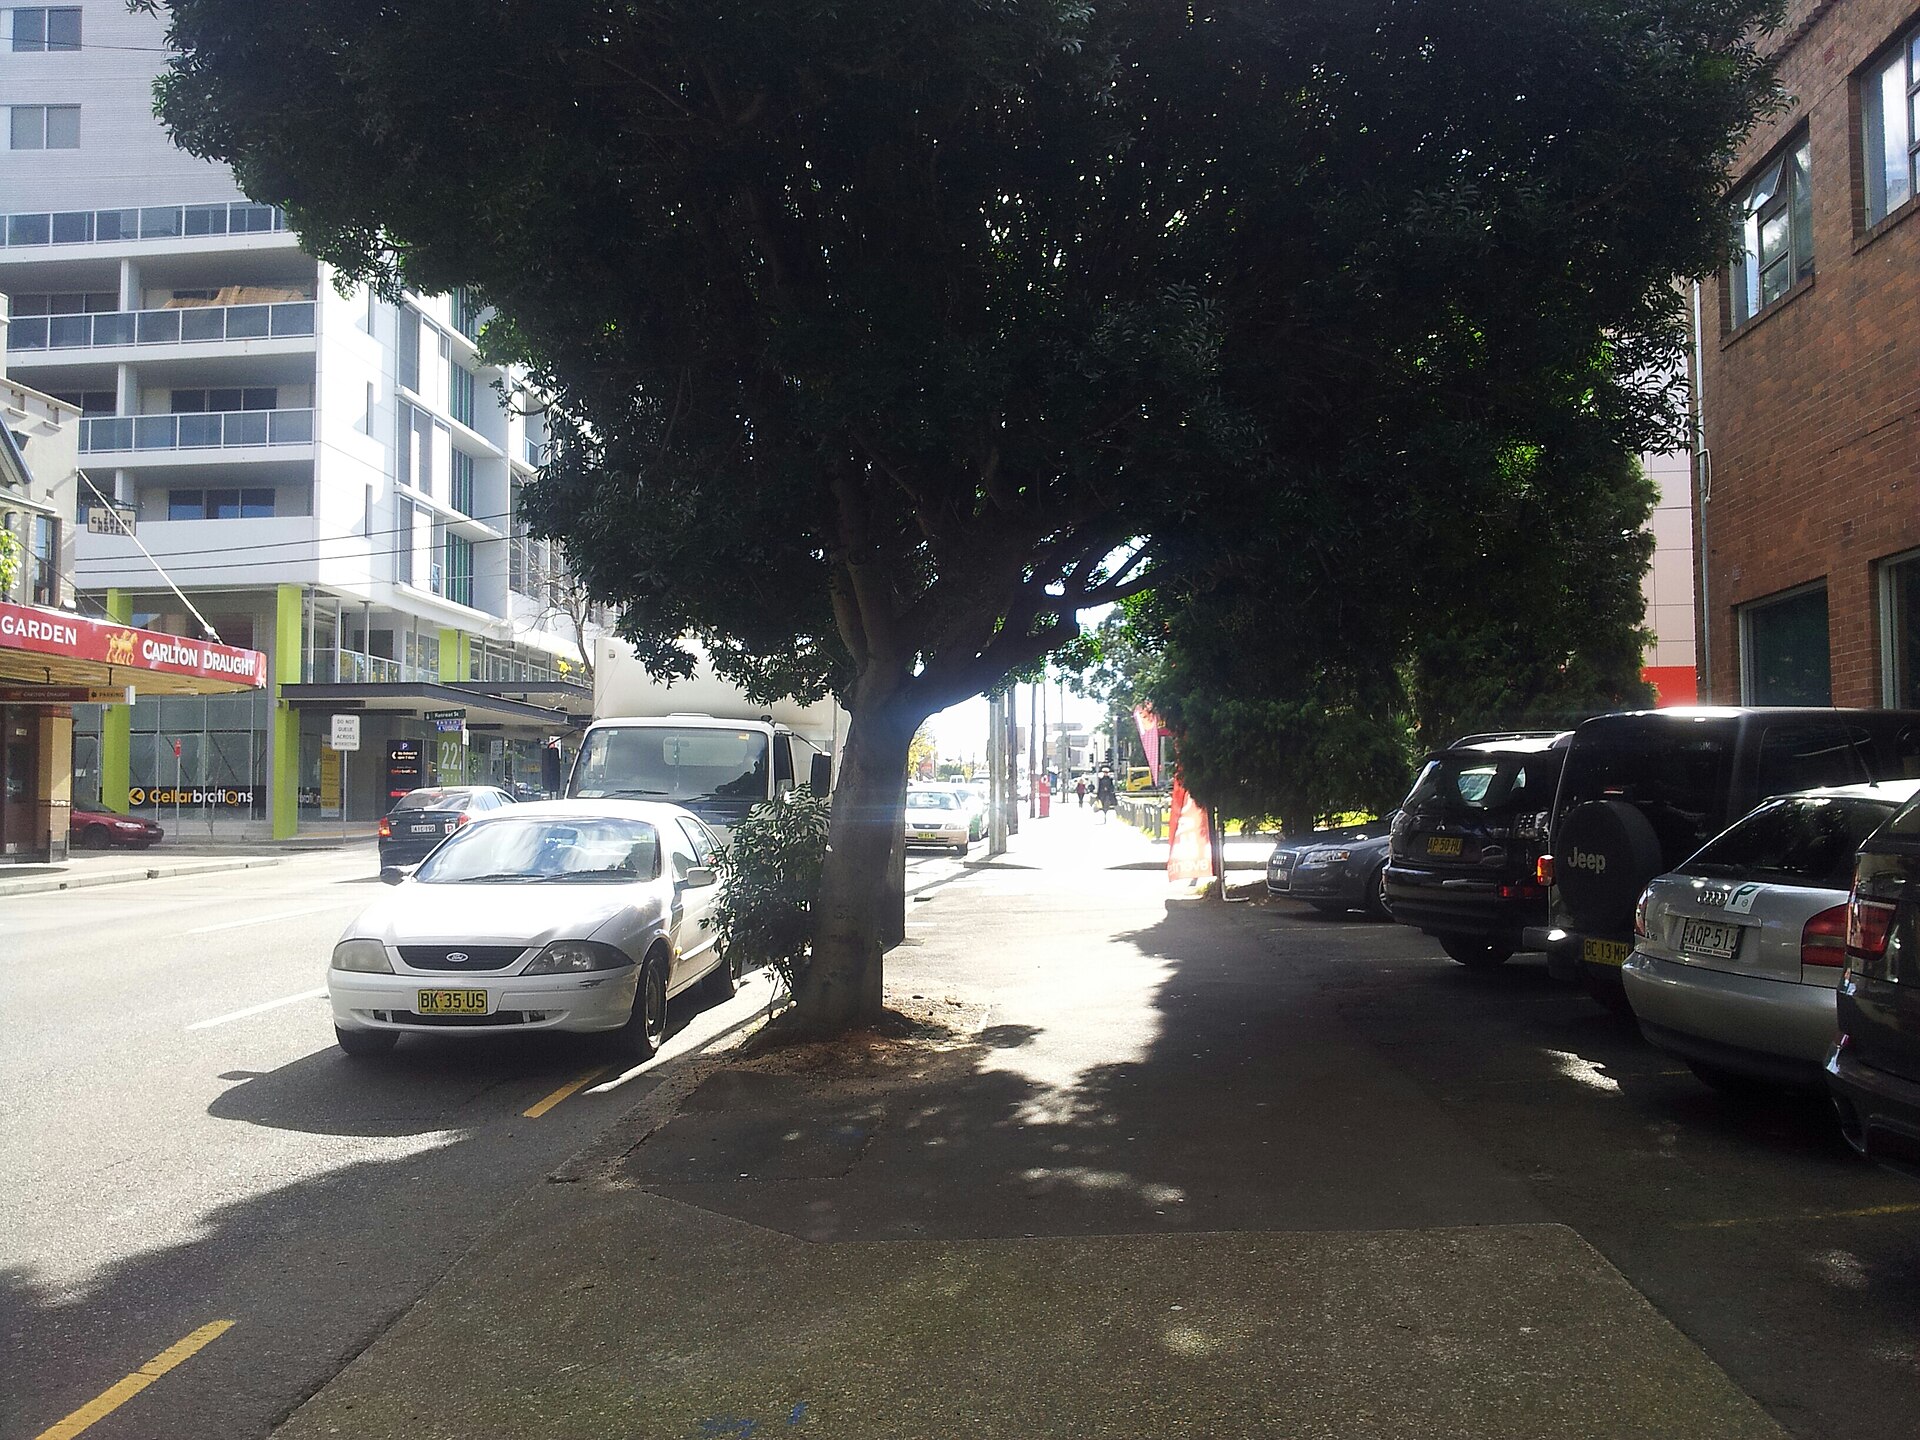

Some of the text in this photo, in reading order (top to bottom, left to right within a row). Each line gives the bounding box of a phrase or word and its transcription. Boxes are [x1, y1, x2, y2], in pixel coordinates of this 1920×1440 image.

[1, 615, 77, 646] GARDEN
[142, 639, 255, 676] CARLTON DRAUGHT
[149, 788, 254, 805] Cellarbrations
[1567, 846, 1606, 874] Jeep
